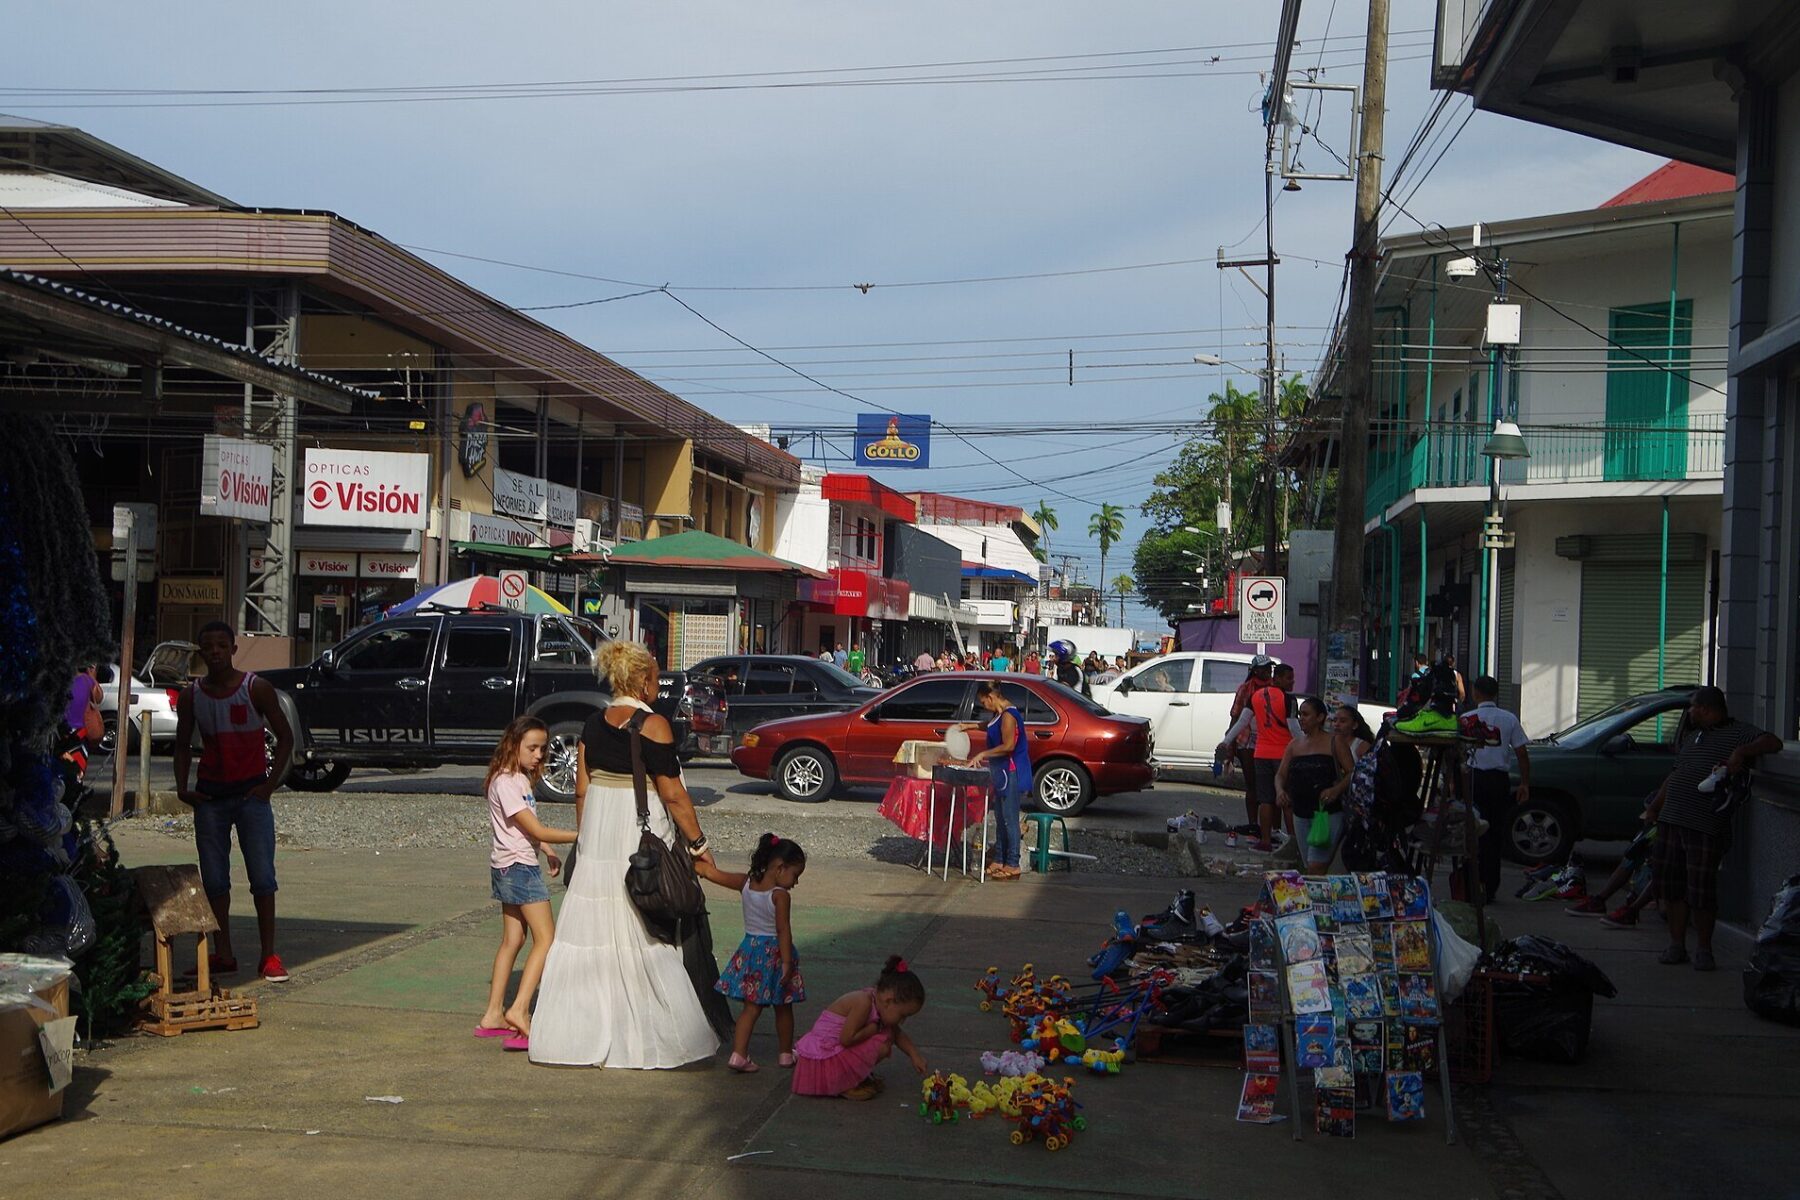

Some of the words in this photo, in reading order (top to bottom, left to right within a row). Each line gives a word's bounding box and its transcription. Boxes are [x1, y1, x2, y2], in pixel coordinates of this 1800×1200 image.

[221, 451, 249, 466] OPTICAS
[866, 445, 918, 458] GOLLO
[308, 463, 370, 476] OPTICAS
[512, 479, 523, 493] SE
[479, 525, 505, 542] OPTICAS
[506, 598, 520, 609] NO
[345, 728, 424, 743] ISUZU
